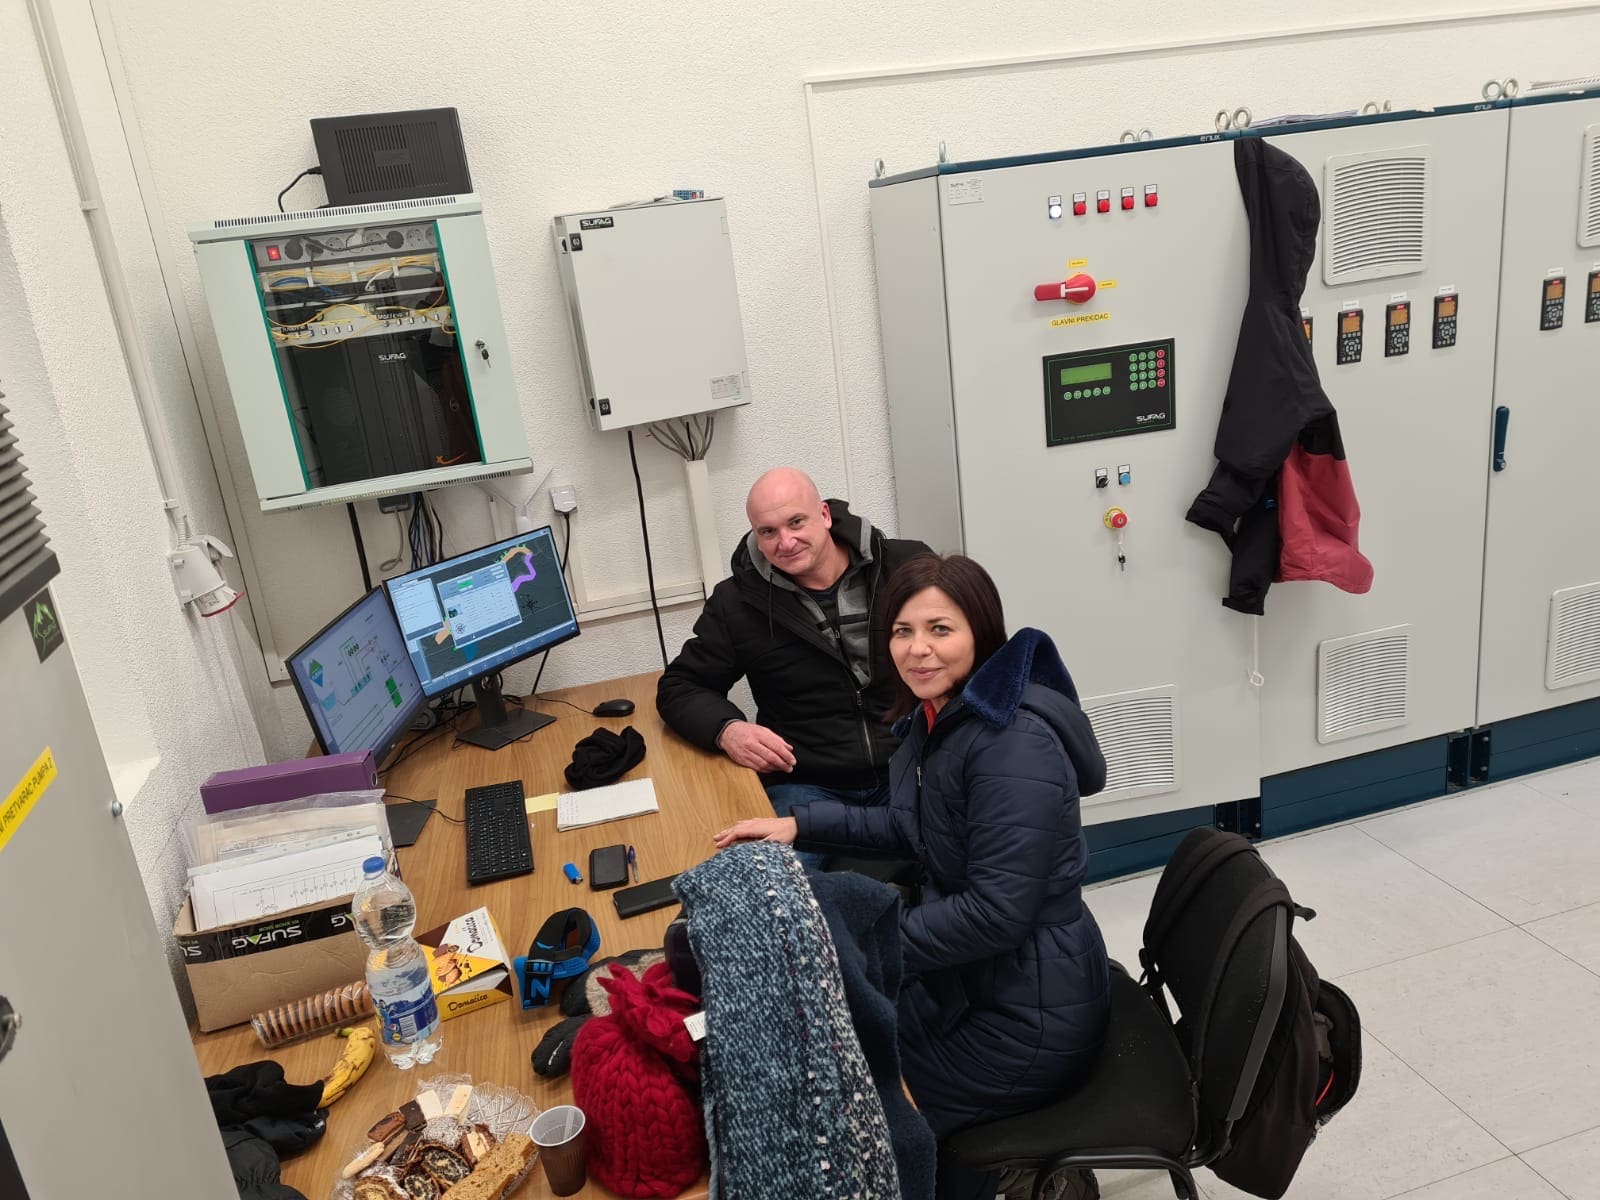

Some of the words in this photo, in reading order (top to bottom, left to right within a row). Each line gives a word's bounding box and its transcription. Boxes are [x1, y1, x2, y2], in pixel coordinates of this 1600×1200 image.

[581, 217, 612, 227] SUFAG
[1052, 317, 1076, 327] GLAVNI
[378, 352, 406, 361] SUFAG
[1136, 412, 1166, 422] SUFAG
[232, 925, 302, 949] SUFAG
